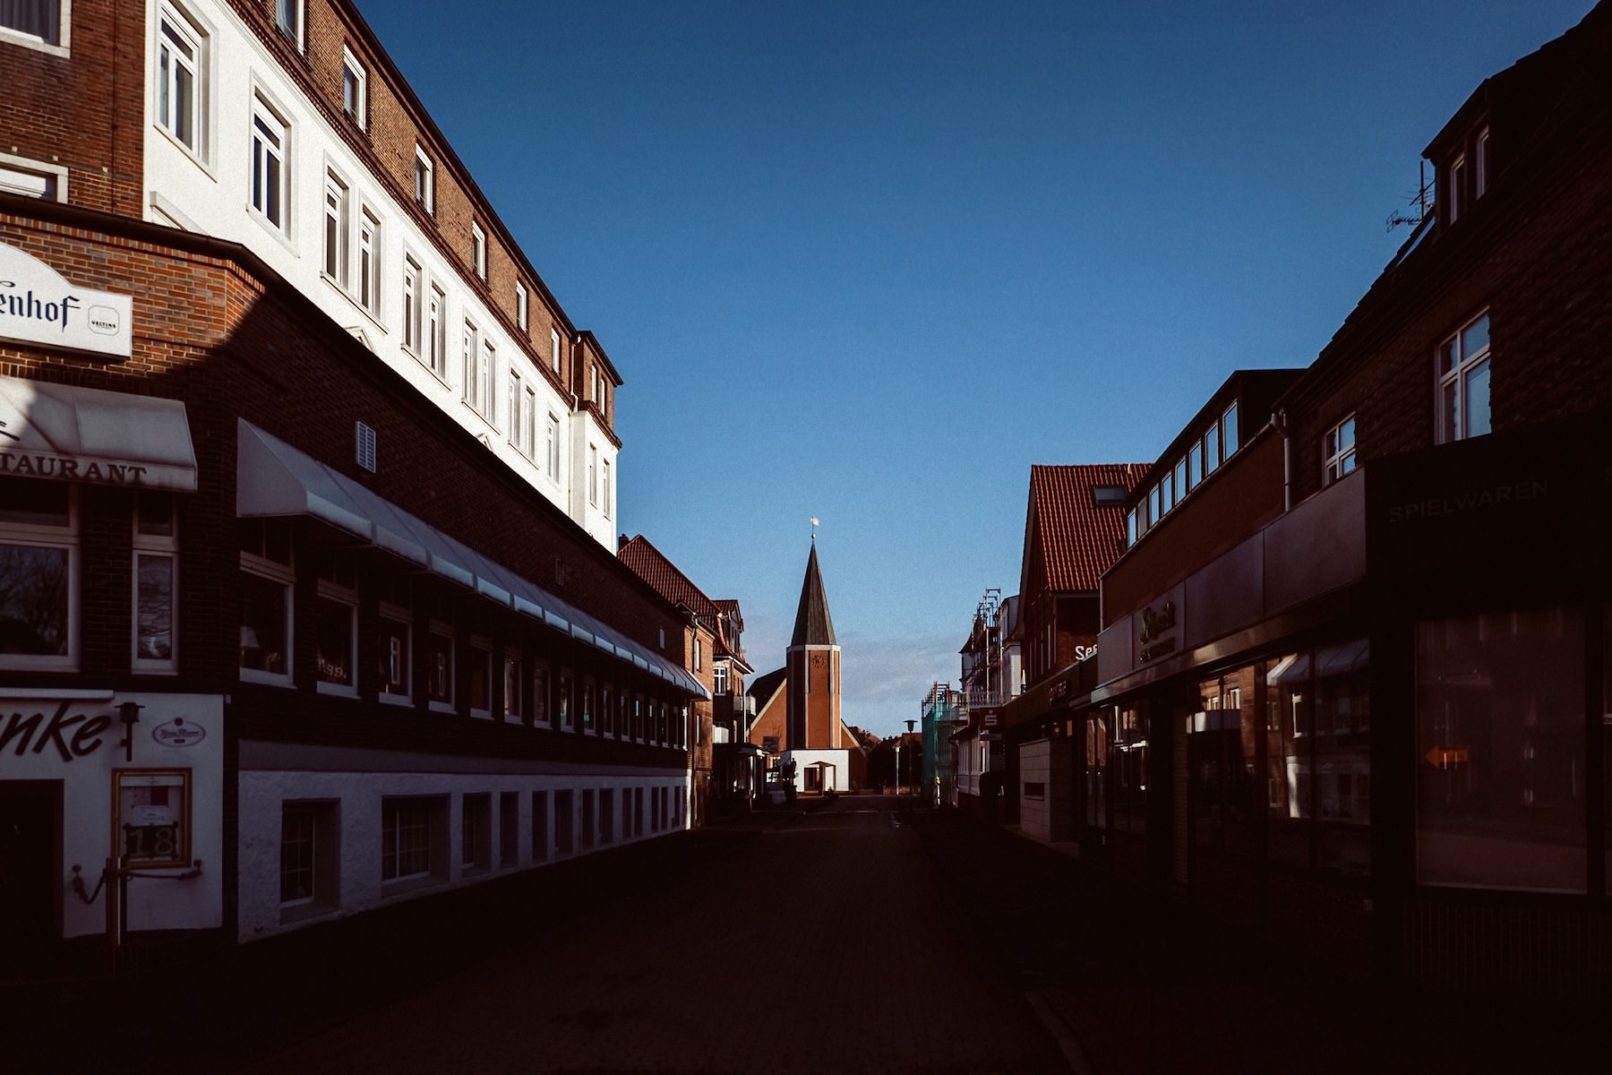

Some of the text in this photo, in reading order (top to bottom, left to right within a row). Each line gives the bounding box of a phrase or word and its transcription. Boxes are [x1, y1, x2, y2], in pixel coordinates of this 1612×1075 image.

[0, 281, 81, 334] enhof
[1389, 479, 1549, 523] SPIELWAREN
[0, 700, 111, 762] nke
[129, 826, 173, 856] 18
